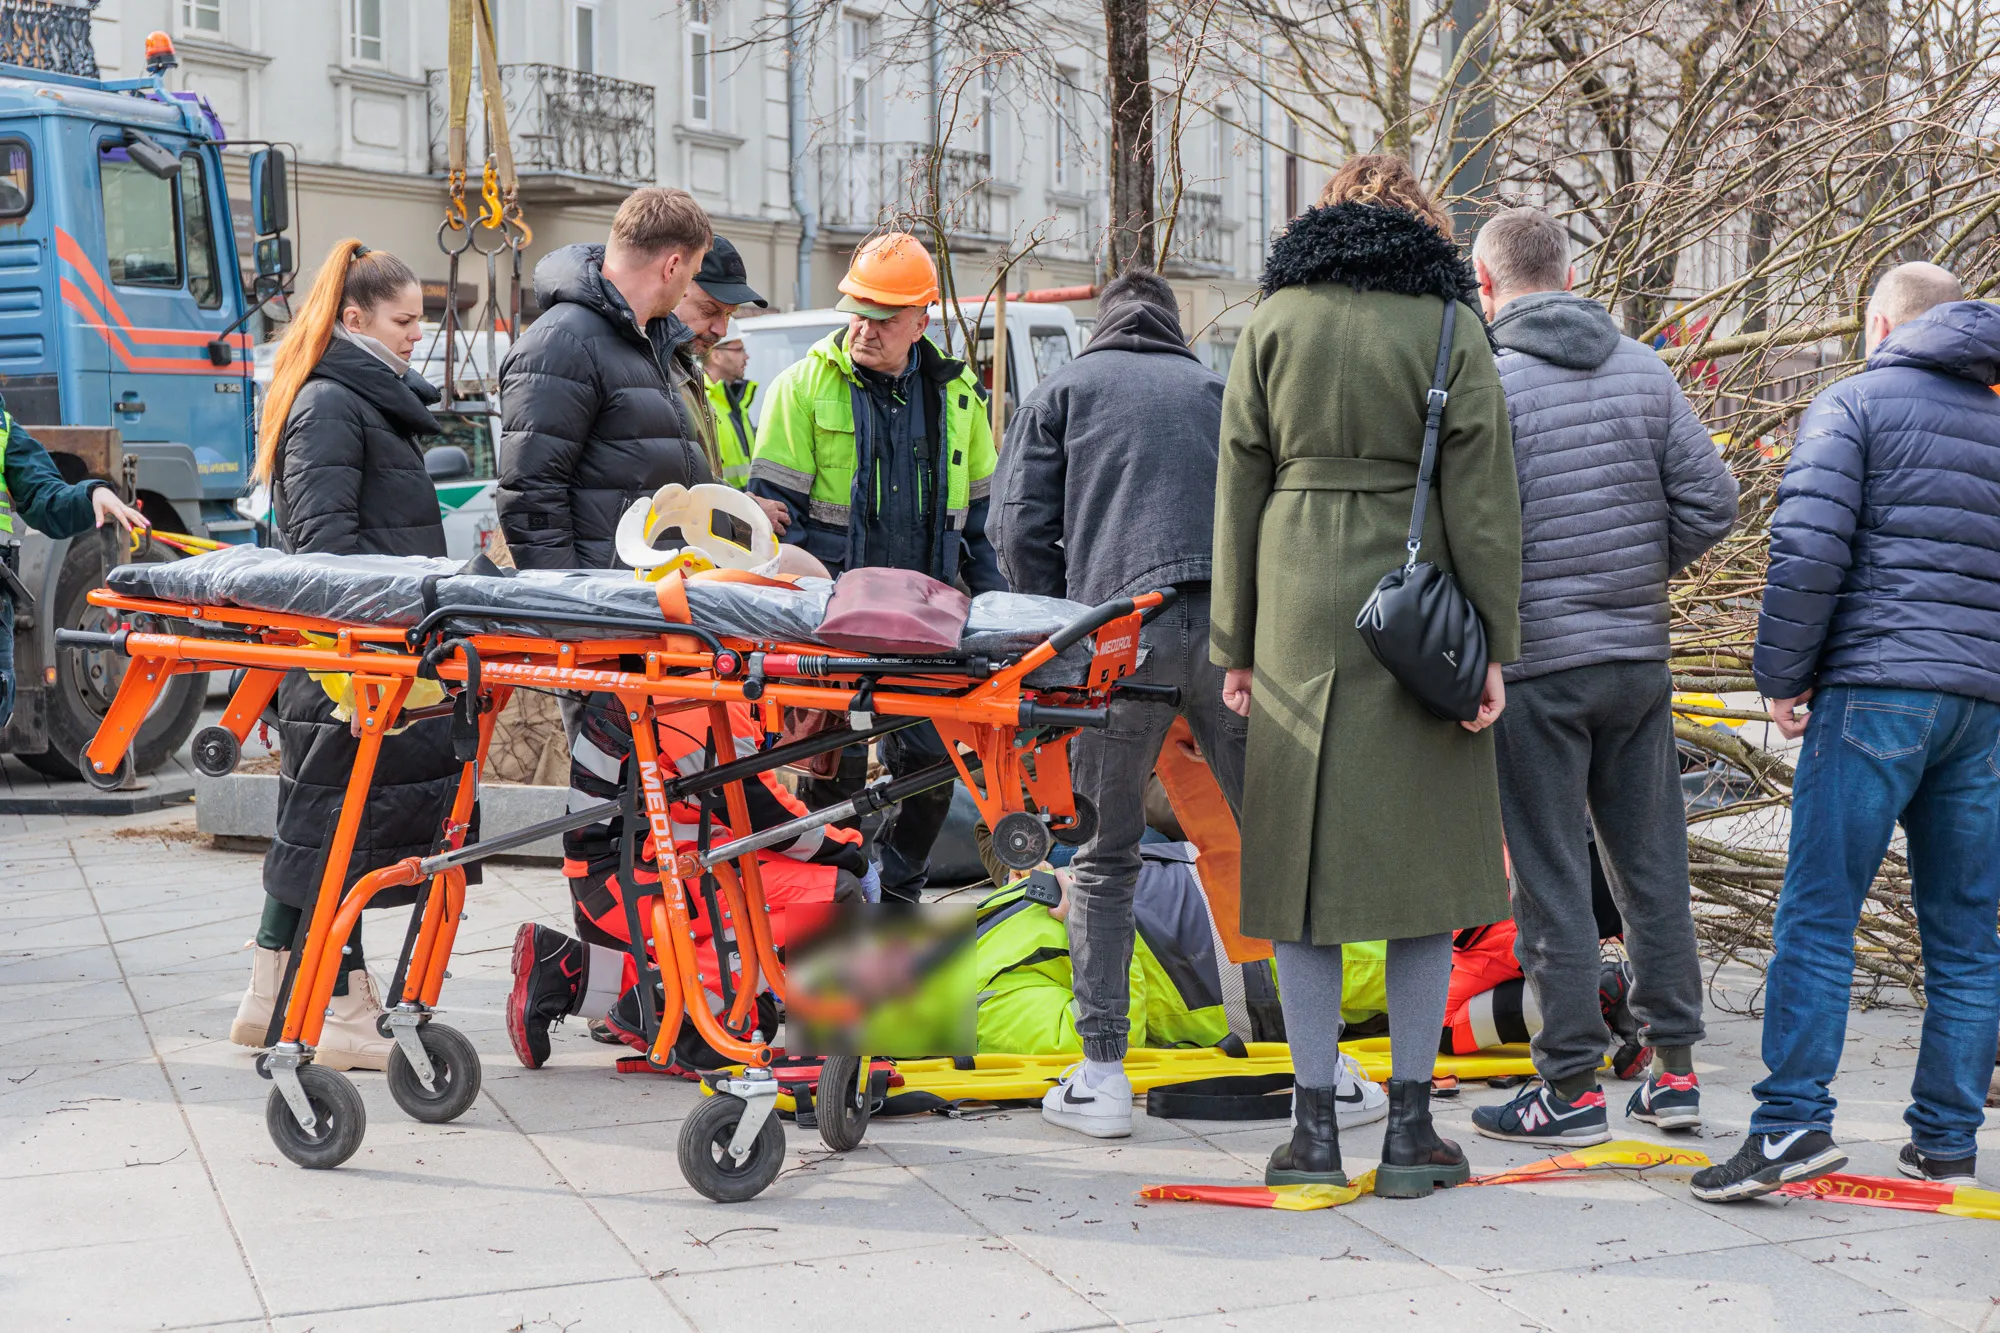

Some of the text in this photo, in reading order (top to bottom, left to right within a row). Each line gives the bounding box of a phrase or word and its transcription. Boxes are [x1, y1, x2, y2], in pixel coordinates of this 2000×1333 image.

[1100, 635, 1132, 656] MEDIROL
[639, 760, 686, 911] MEDIRO
[1810, 1178, 1895, 1201] STOP
